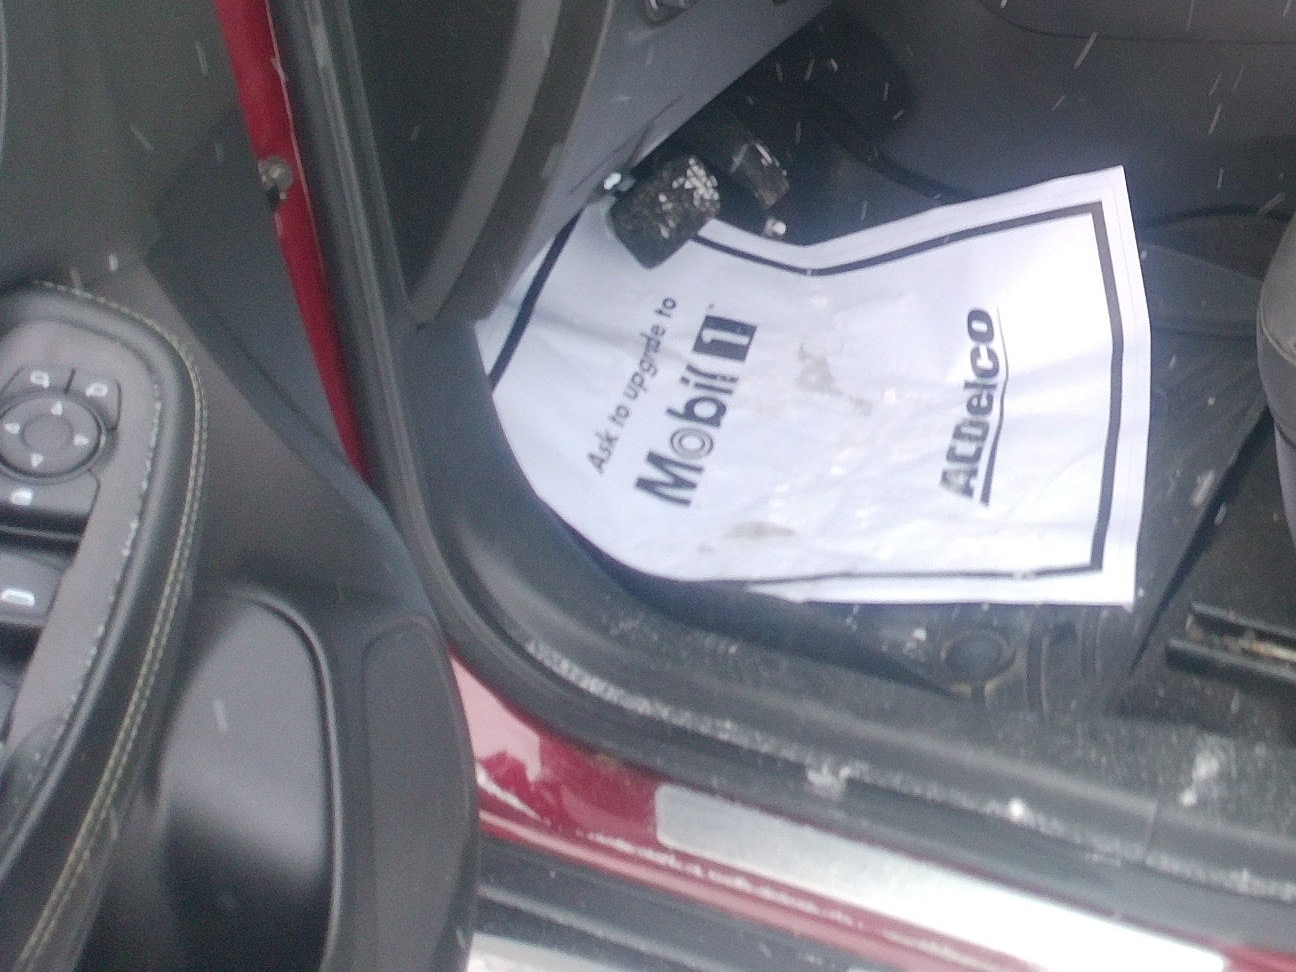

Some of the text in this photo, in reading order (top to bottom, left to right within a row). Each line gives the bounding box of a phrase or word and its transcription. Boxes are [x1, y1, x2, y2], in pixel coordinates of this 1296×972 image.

[587, 428, 619, 475] Ask
[608, 404, 631, 428] to
[654, 296, 677, 319] to
[634, 363, 740, 507] Mobil
[940, 308, 1000, 499] ACDelco
